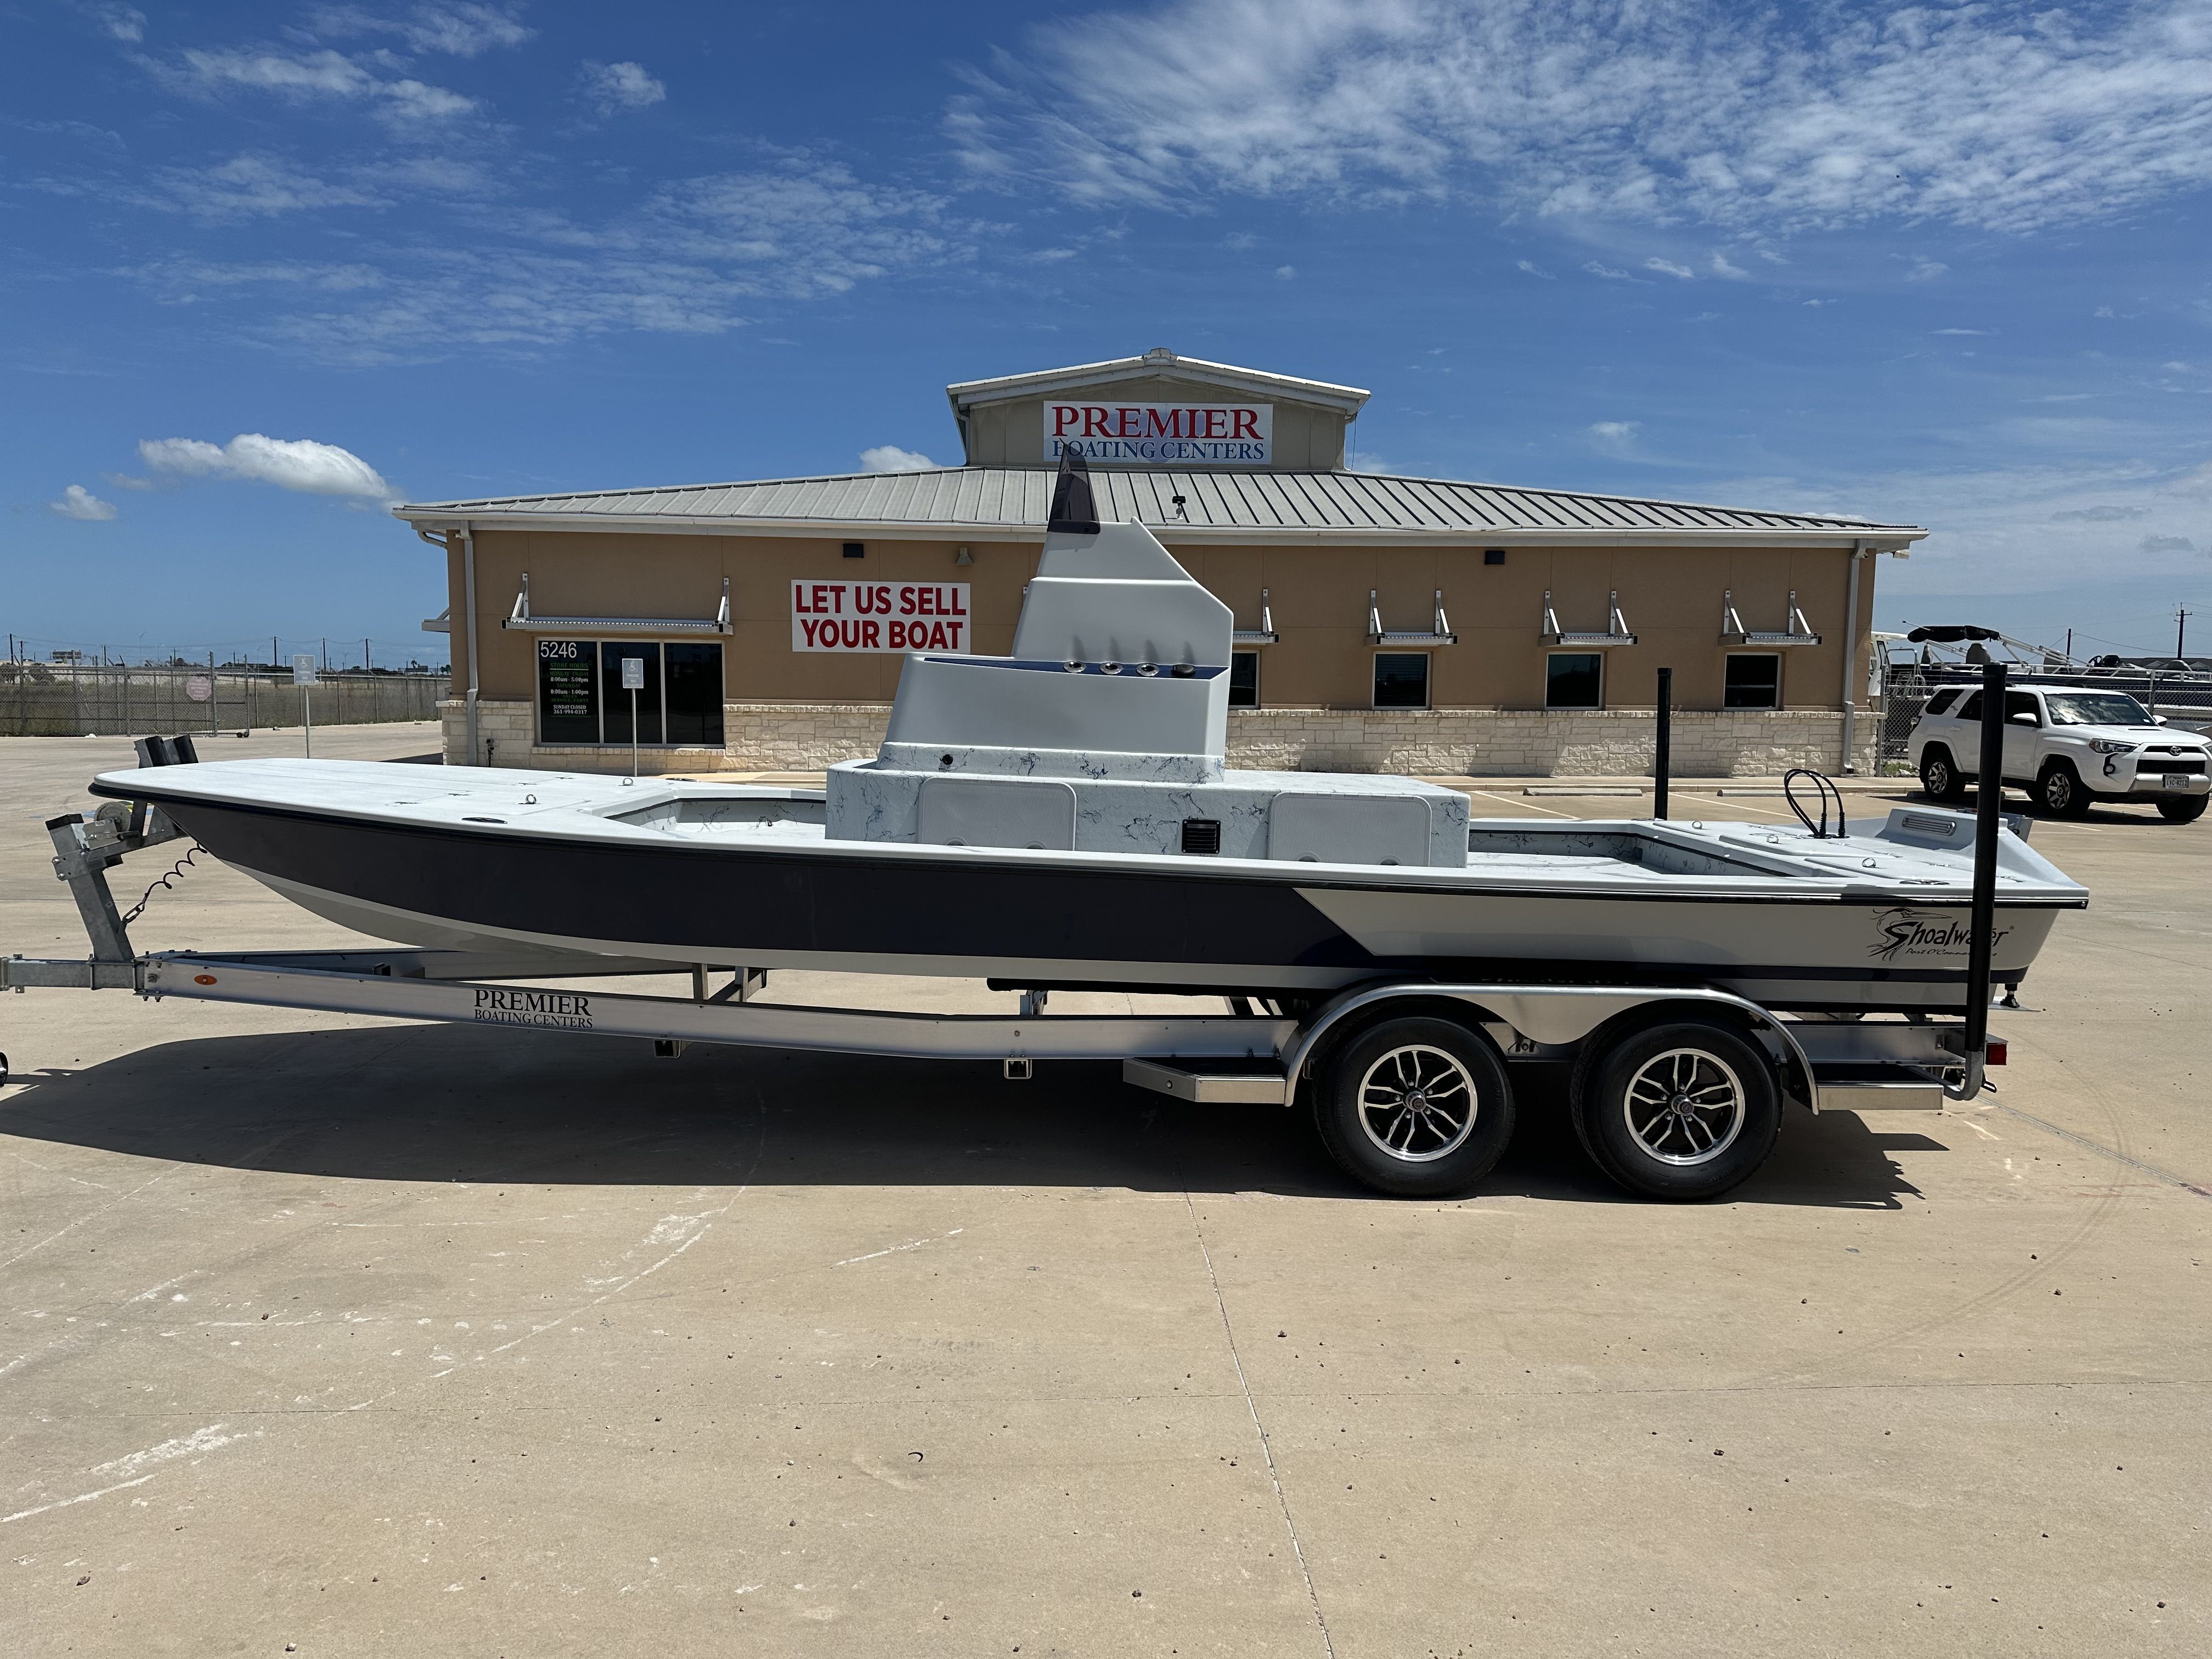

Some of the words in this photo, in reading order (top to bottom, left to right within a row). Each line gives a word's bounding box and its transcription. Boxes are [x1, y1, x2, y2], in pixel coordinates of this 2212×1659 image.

[1052, 406, 1264, 440] PREMIER
[1160, 442, 1265, 460] CENTERS
[796, 585, 846, 613] LET
[855, 586, 891, 614] US
[899, 586, 966, 615] SELL
[800, 619, 880, 648] YOUR
[889, 620, 963, 649] BOAT
[540, 641, 577, 658] 5246
[1867, 921, 2009, 957] Shoalwr
[474, 989, 592, 1016] PREMIER
[474, 1009, 531, 1025] BOATING
[533, 1014, 593, 1029] CENTERS
